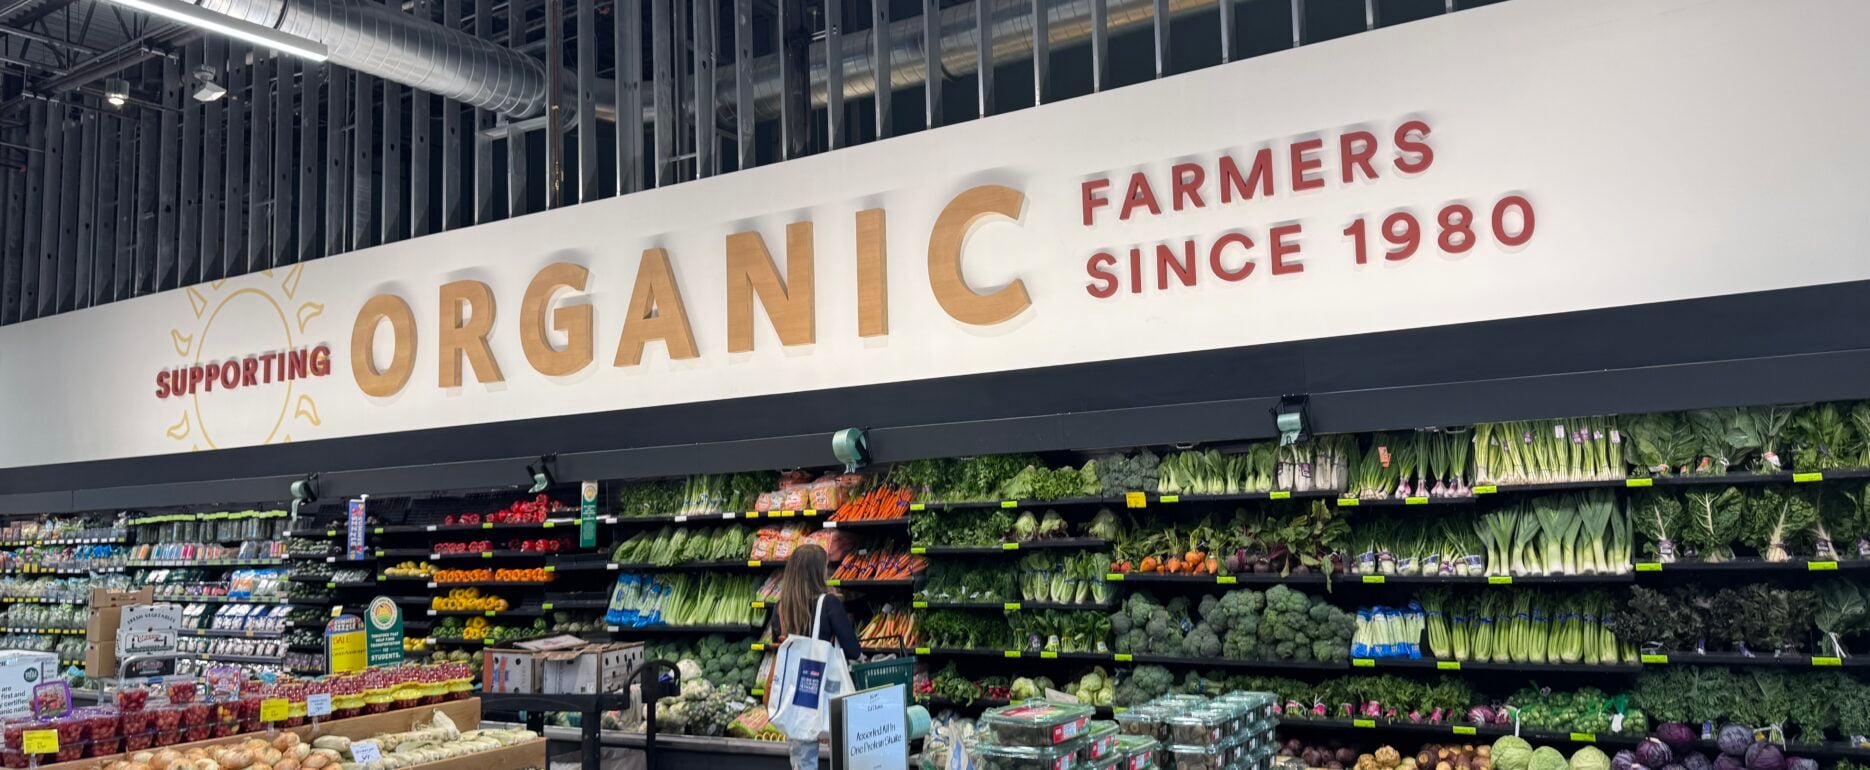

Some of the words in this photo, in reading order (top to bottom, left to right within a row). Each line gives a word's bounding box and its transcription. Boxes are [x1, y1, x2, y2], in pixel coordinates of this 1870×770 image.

[1081, 120, 1434, 226] FARMERS
[350, 183, 1032, 398] ORGANIC
[1085, 224, 1304, 299] SINCE
[1343, 195, 1536, 264] 1980
[155, 345, 331, 399] SUPPORTING
